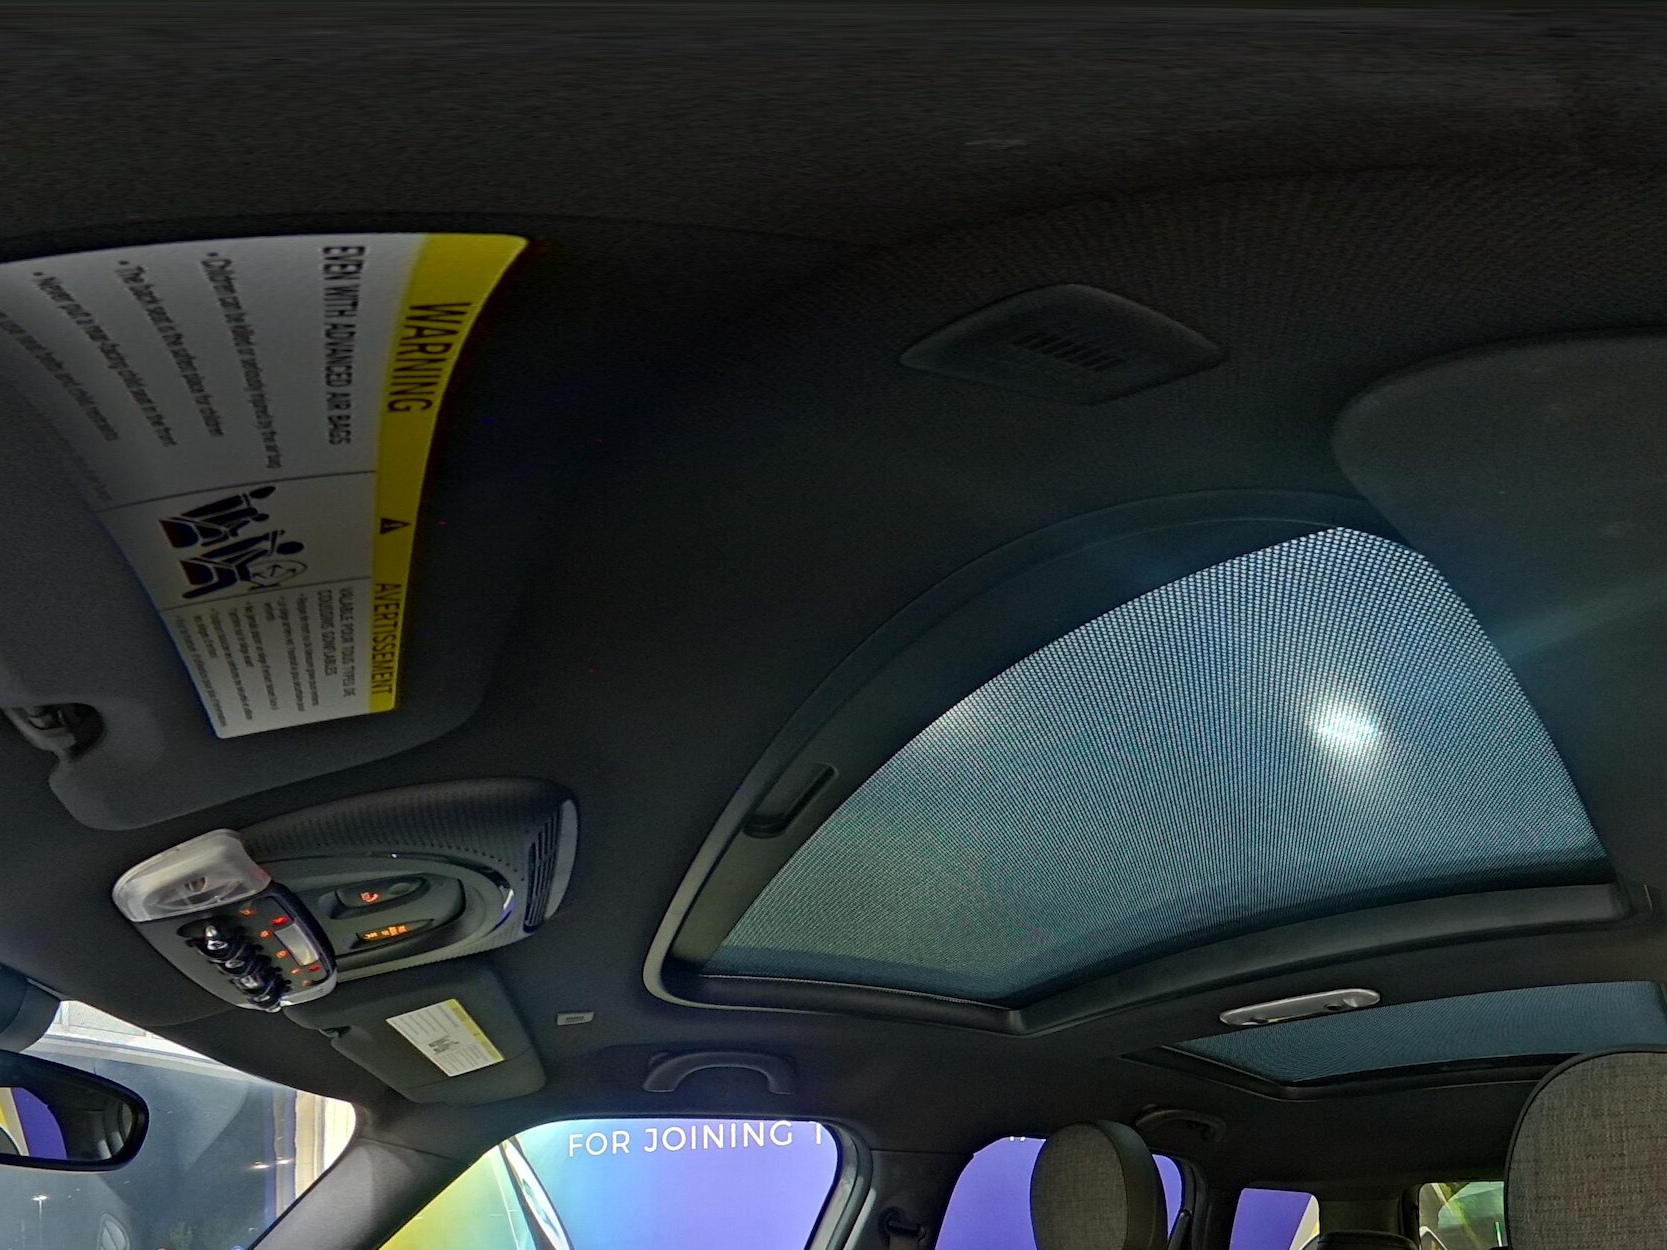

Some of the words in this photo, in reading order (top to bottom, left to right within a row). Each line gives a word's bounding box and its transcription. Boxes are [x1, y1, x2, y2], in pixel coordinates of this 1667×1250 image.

[115, 265, 146, 284] The
[201, 259, 236, 294] Children
[323, 246, 365, 280] EVEN
[323, 284, 360, 318] WITH
[324, 323, 356, 387] ADVANCED
[387, 302, 472, 413] WARNING
[326, 392, 351, 411] AIR
[327, 414, 351, 445] BAGS
[371, 582, 402, 695] AVERTISSEMENT
[568, 1130, 630, 1157] FOR
[643, 1120, 793, 1153] JOINING
